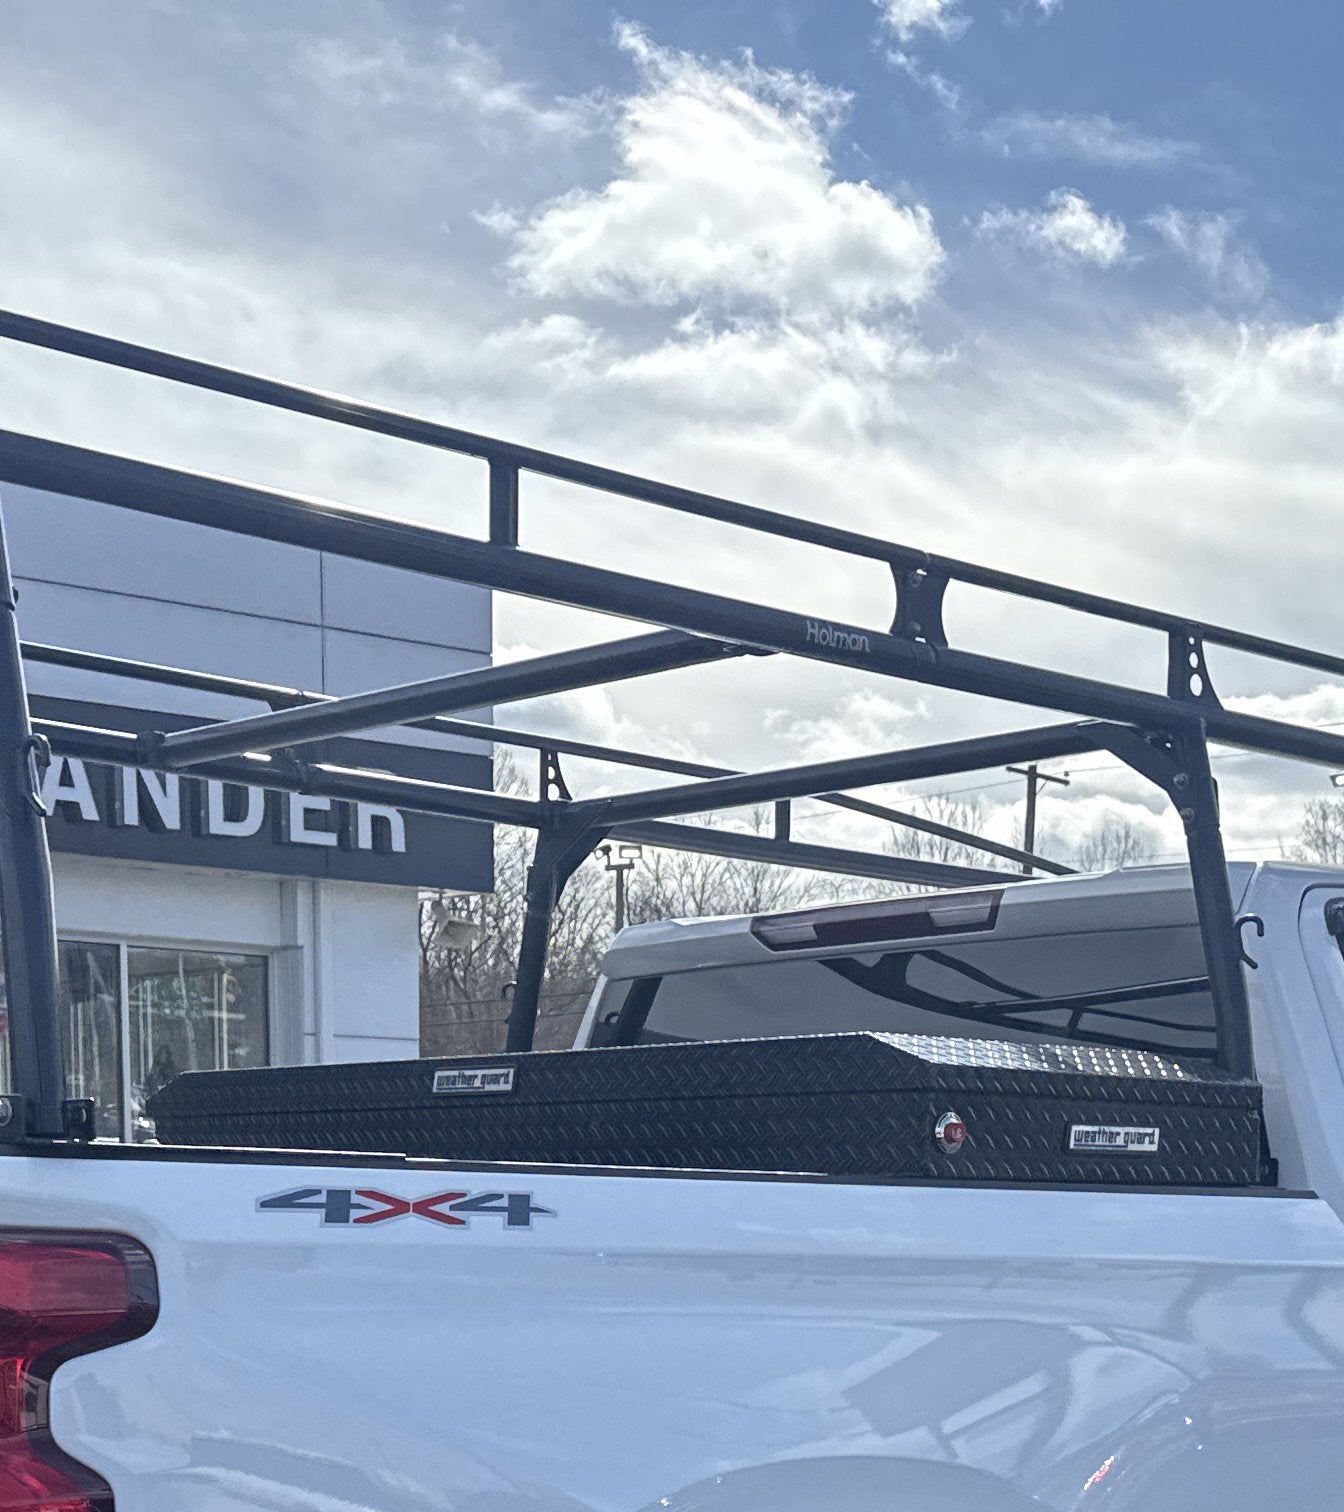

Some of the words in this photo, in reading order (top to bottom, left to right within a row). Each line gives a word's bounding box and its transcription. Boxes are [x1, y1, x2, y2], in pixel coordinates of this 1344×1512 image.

[805, 618, 870, 653] Holman
[436, 1072, 479, 1087] weather
[480, 1070, 511, 1089] guard
[1073, 1127, 1121, 1144] weather
[1122, 1129, 1156, 1148] guard
